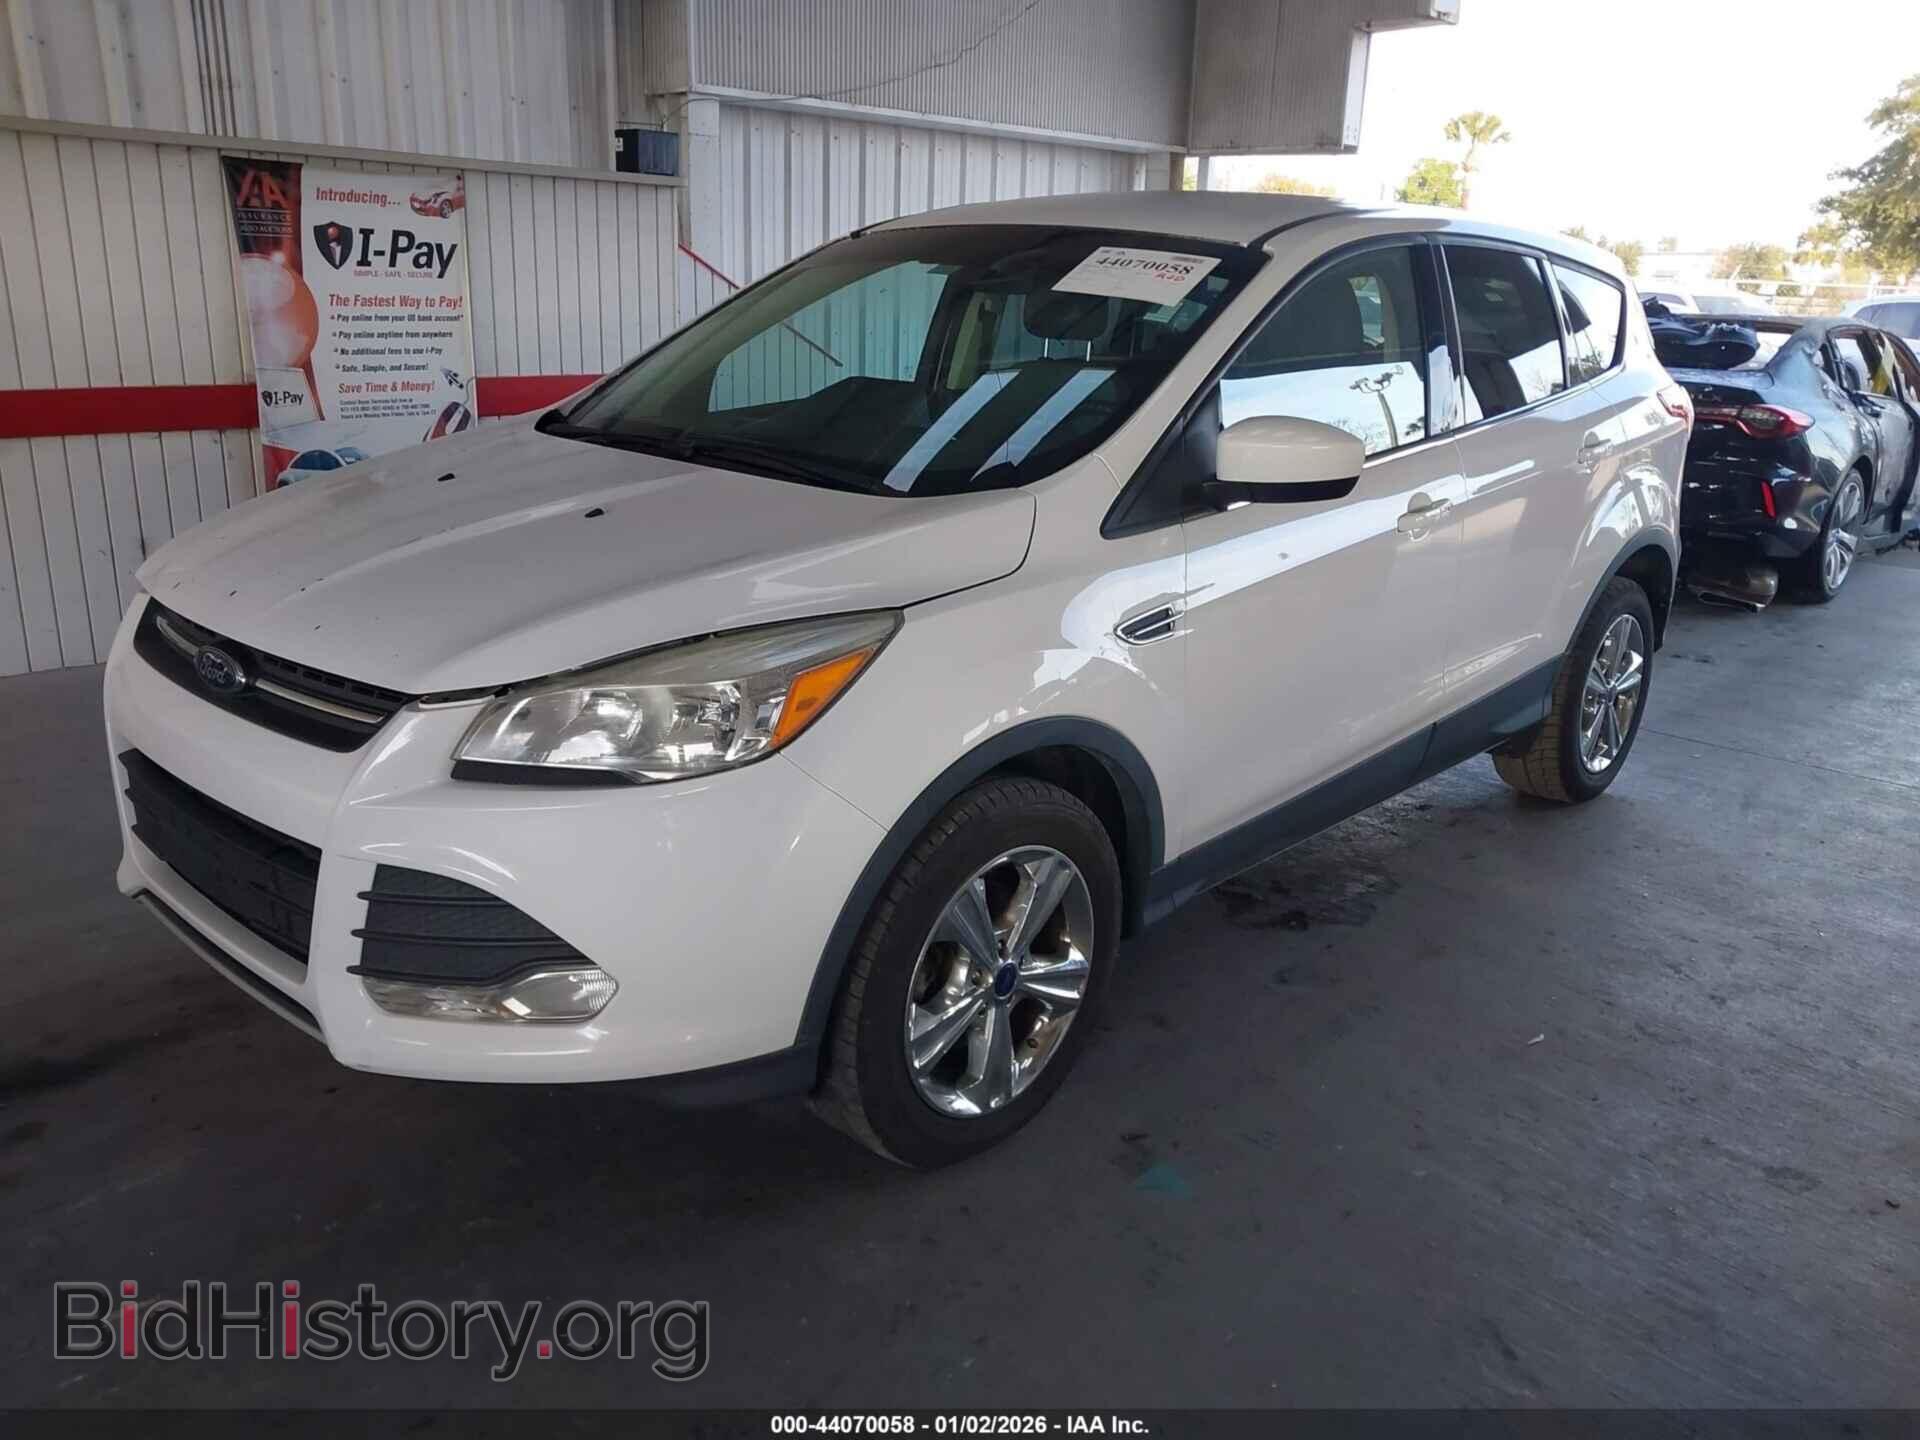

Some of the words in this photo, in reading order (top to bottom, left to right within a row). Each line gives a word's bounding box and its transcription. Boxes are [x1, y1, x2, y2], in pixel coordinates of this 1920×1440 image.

[316, 187, 401, 208] Introducing...
[356, 227, 458, 279] I-Pay
[1096, 256, 1195, 275] 44070058
[329, 294, 350, 307] The
[353, 294, 396, 308] Fastest
[399, 295, 421, 309] Way
[425, 296, 436, 308] to
[439, 295, 463, 310] Pay!
[336, 314, 349, 323] Pay
[391, 314, 406, 323] your
[417, 314, 433, 322] bank
[338, 331, 351, 340] Pay
[353, 331, 375, 339] online
[376, 331, 403, 340] anytime
[405, 331, 420, 339] from
[422, 331, 453, 340] anywhere
[340, 348, 349, 356] No
[351, 347, 386, 356] additional
[387, 347, 402, 355] fees
[362, 364, 388, 373] Simple,
[403, 363, 429, 371] Secure!
[338, 382, 362, 394] Save
[365, 382, 388, 393] Time
[391, 381, 398, 393] &
[401, 380, 436, 393] Money!
[274, 391, 304, 406] I-Pay
